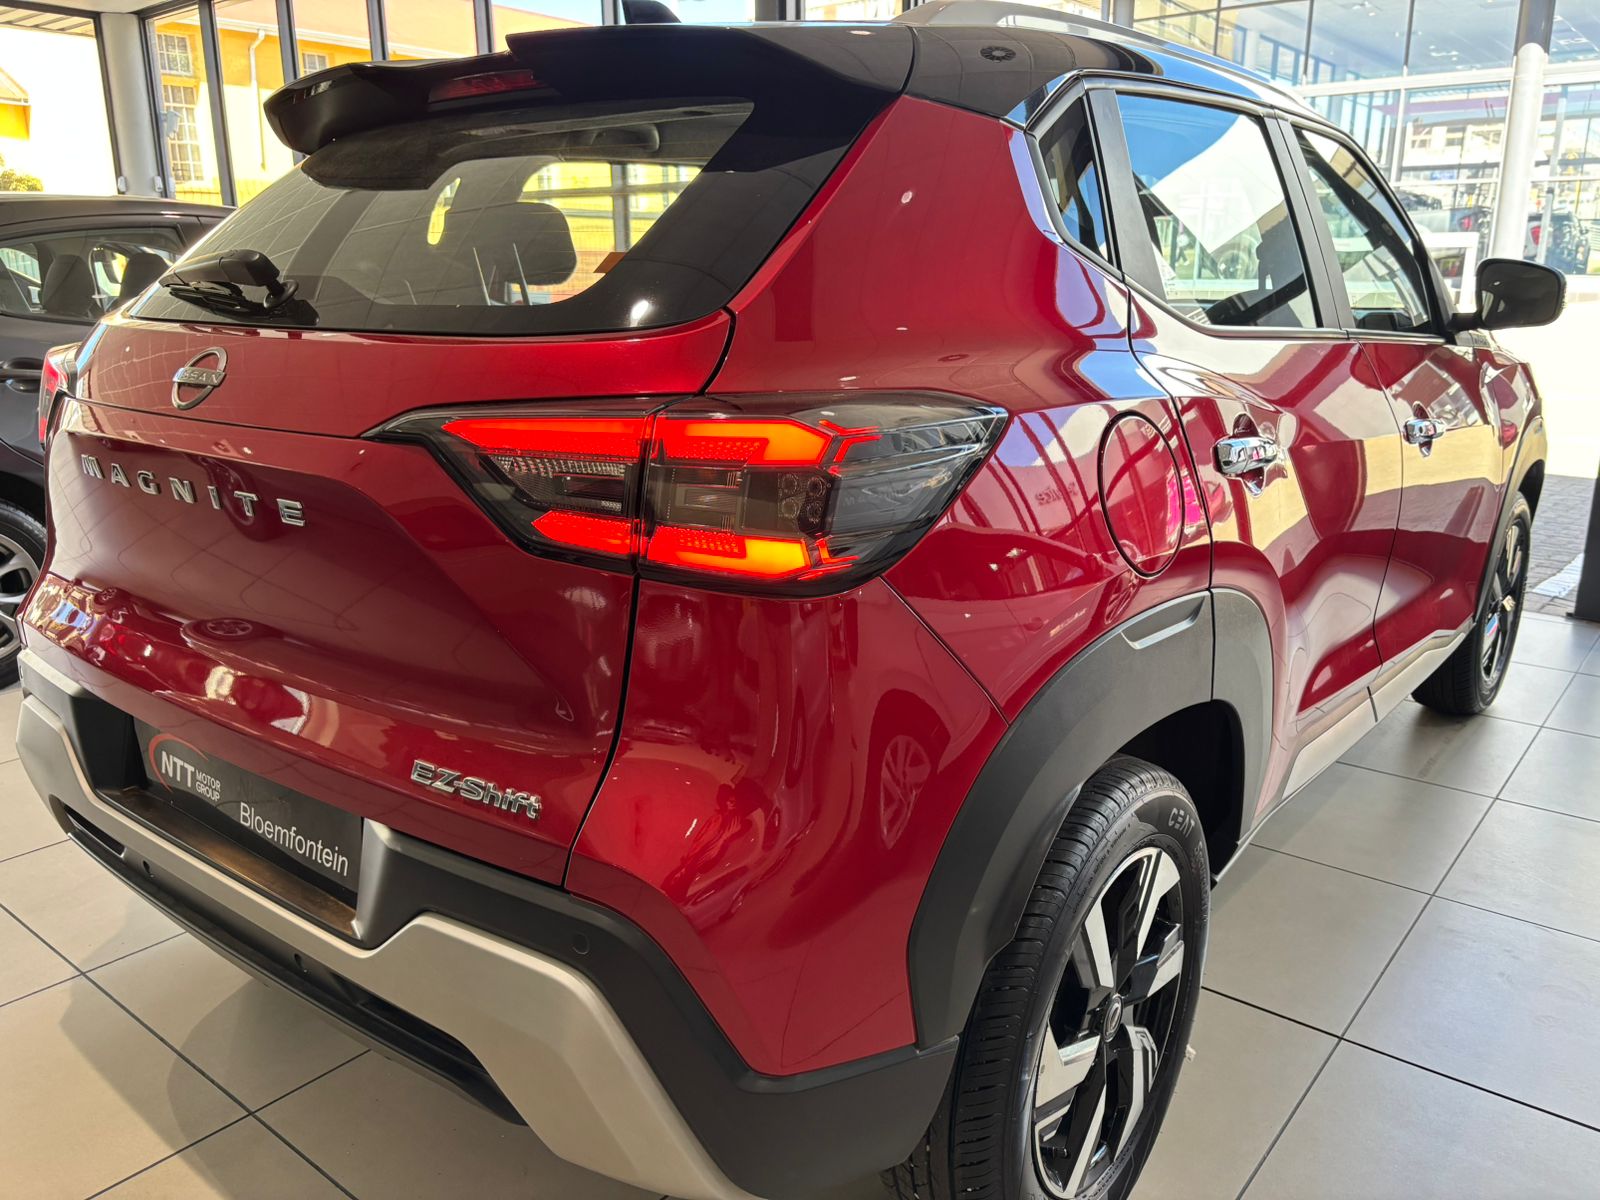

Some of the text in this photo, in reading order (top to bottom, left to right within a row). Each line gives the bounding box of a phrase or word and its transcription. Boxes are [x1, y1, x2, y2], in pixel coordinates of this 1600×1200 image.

[80, 453, 305, 527] MAGNITE
[161, 750, 195, 788] NTT
[195, 769, 221, 792] MOTOR
[195, 781, 221, 802] GROUP
[411, 759, 541, 819] EZ-Shift
[239, 802, 349, 876] Bloemfontein
